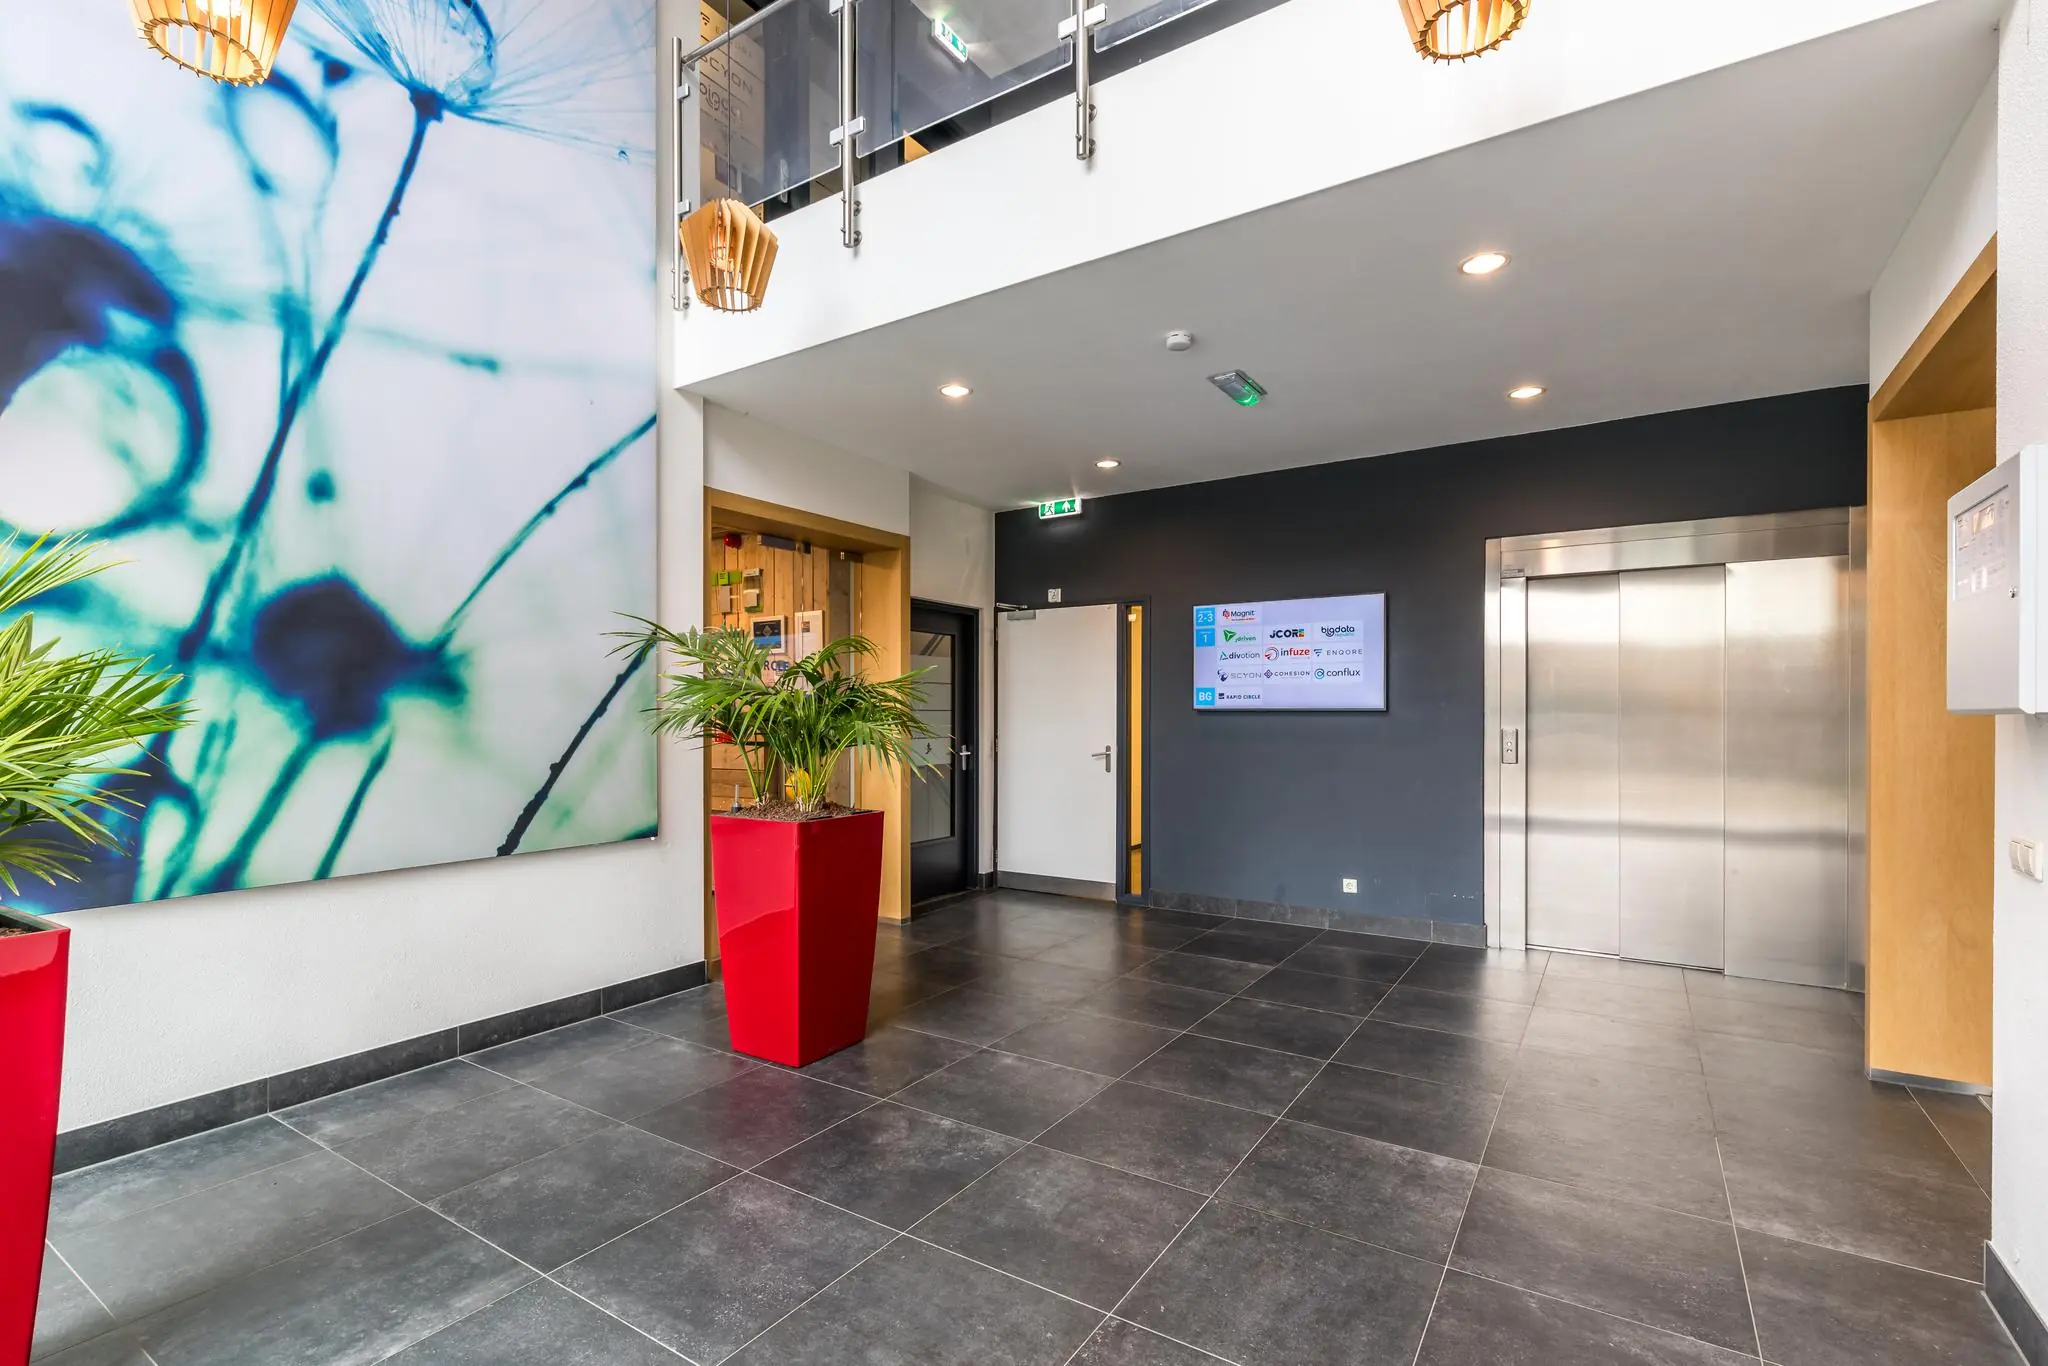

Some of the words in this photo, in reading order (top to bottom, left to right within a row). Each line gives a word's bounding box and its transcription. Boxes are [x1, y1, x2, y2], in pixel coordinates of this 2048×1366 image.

[1198, 613, 1214, 623] 2-3
[1230, 610, 1256, 618] Magnit
[1321, 625, 1355, 637] bigdata
[1228, 651, 1261, 660] divotion
[1280, 647, 1311, 657] infuze
[1326, 667, 1361, 677] conflux
[1198, 691, 1213, 702] BG
